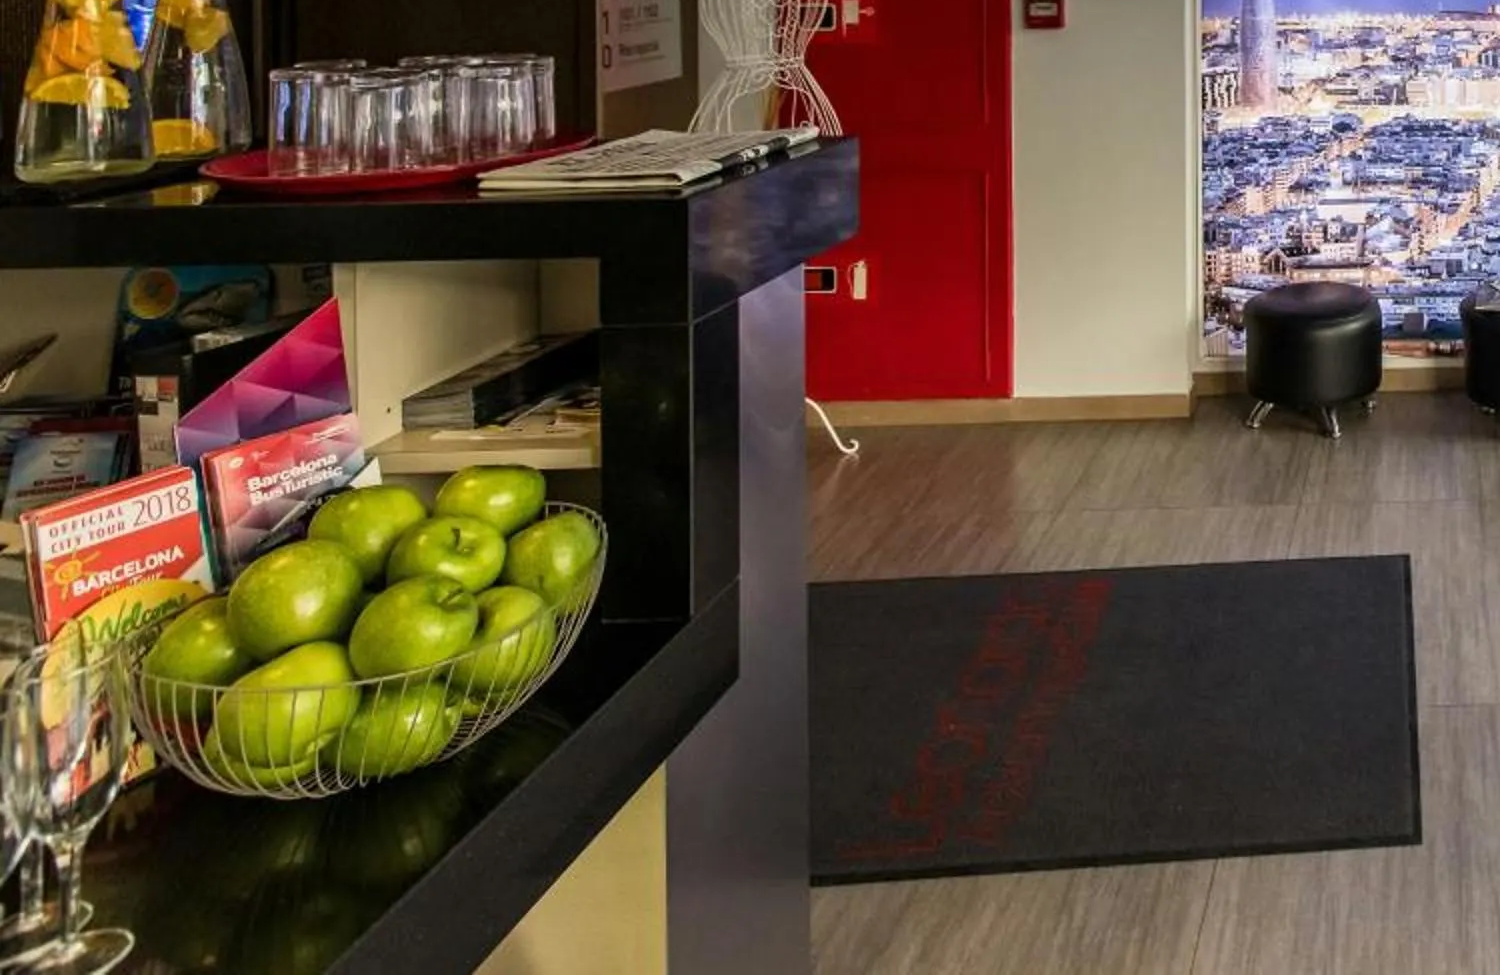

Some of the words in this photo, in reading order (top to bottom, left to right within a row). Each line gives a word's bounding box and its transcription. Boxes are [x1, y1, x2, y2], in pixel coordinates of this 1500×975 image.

[602, 11, 610, 35] 1
[602, 44, 612, 68] 0
[247, 454, 337, 492] Barcelona
[132, 485, 192, 526] 2018
[48, 507, 126, 538] OFFICIAL
[50, 536, 82, 554] CITY
[88, 522, 126, 542] TOUR
[72, 545, 185, 597] BARCELONA
